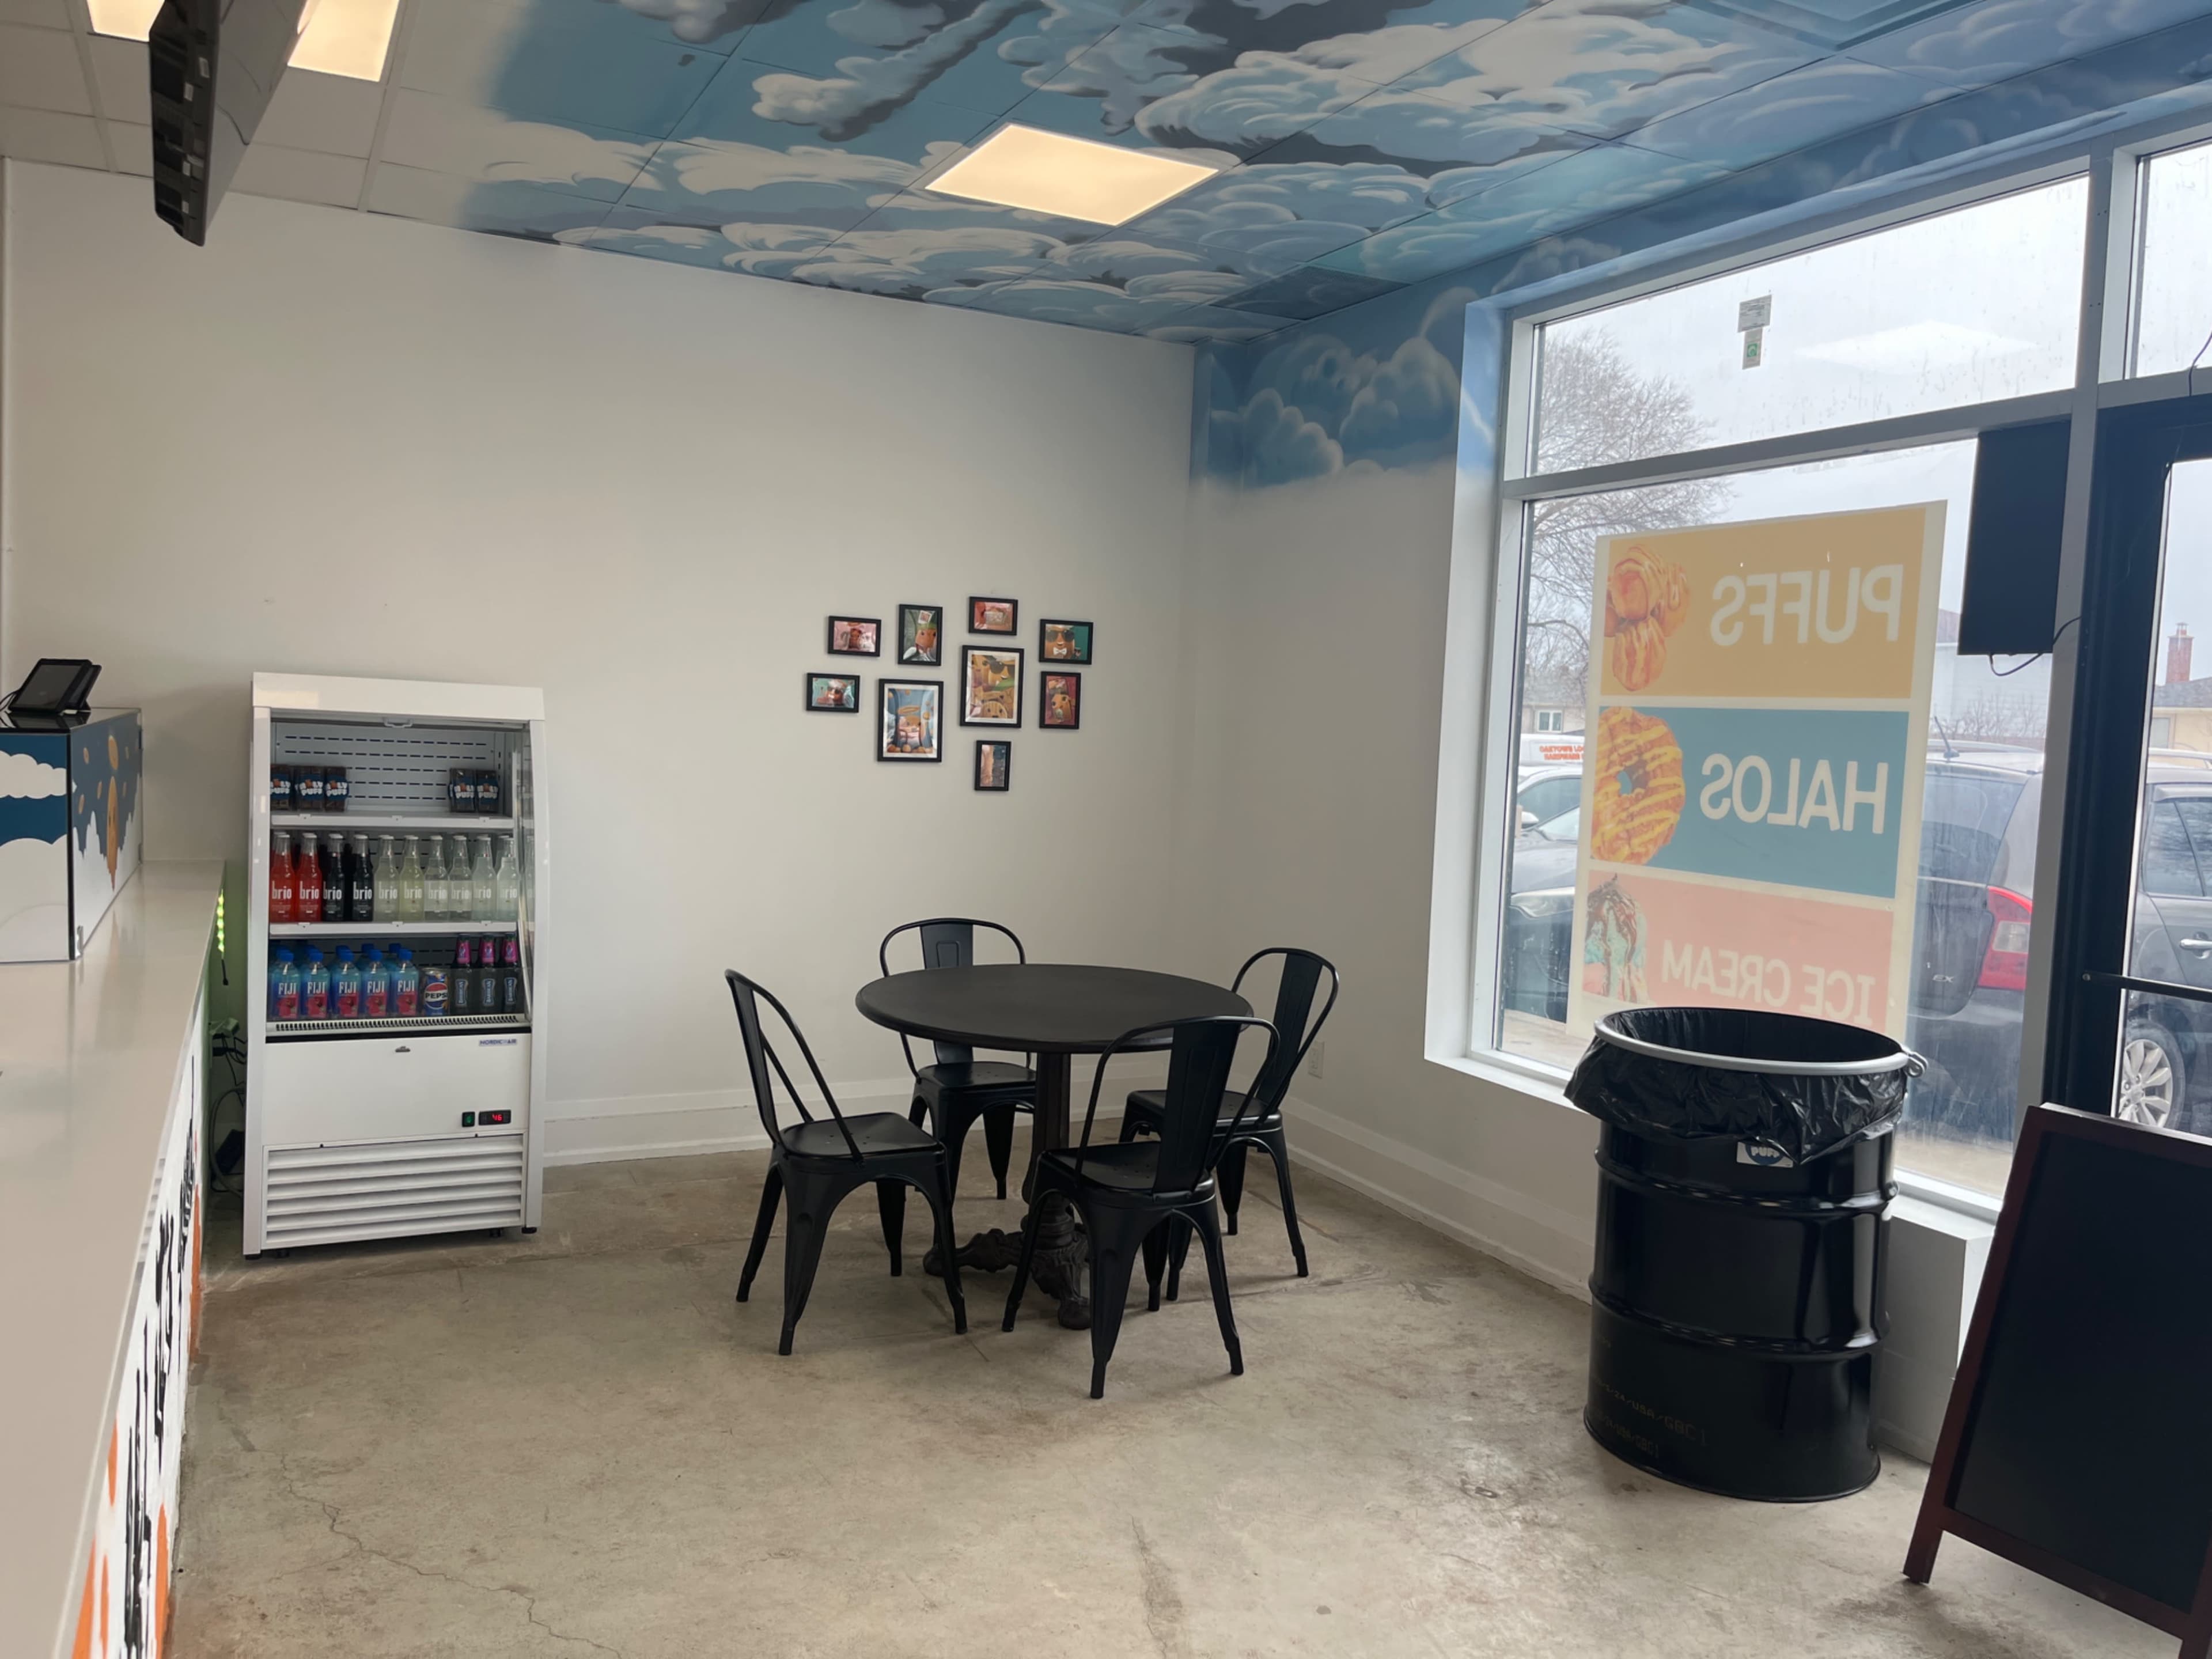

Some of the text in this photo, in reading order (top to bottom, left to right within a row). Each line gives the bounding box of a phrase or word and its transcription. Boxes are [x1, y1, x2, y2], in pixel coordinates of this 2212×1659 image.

[272, 880, 292, 900] brio
[300, 880, 320, 900] brio
[323, 881, 342, 900] brio
[353, 881, 373, 900] brio
[379, 881, 398, 899] brio
[404, 881, 422, 899] brio
[428, 881, 448, 899] brio
[451, 881, 471, 899] brio
[1933, 974, 1955, 983] EX
[279, 983, 296, 995] FIJI
[308, 982, 325, 994] FIJI
[339, 981, 356, 994] FIJI
[367, 981, 385, 993] FIJI
[397, 980, 415, 993] FIJI
[492, 1113, 503, 1122] 46
[1750, 1146, 1781, 1158] PUFF
